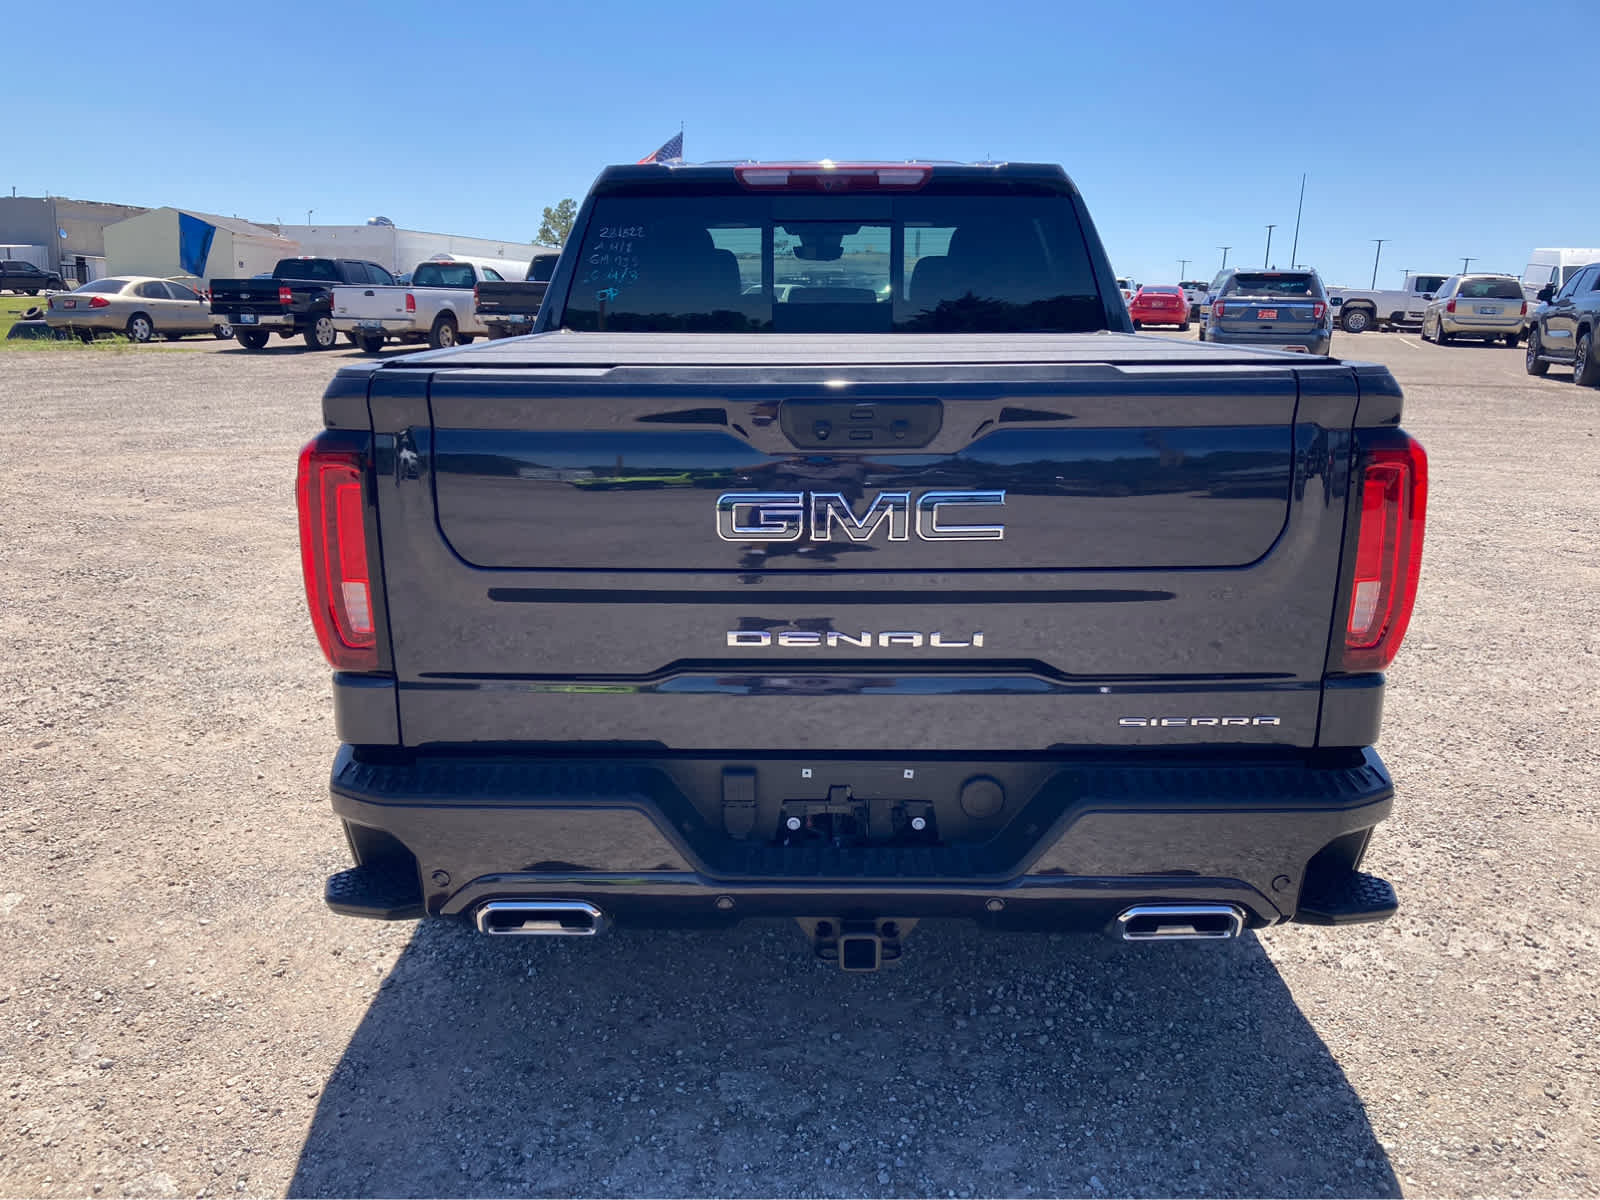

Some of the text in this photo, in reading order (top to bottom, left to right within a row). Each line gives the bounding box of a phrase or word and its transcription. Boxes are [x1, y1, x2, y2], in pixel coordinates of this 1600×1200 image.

[716, 491, 1006, 542] GMC
[726, 630, 984, 648] DENALI
[1119, 716, 1281, 728] SIERRA
